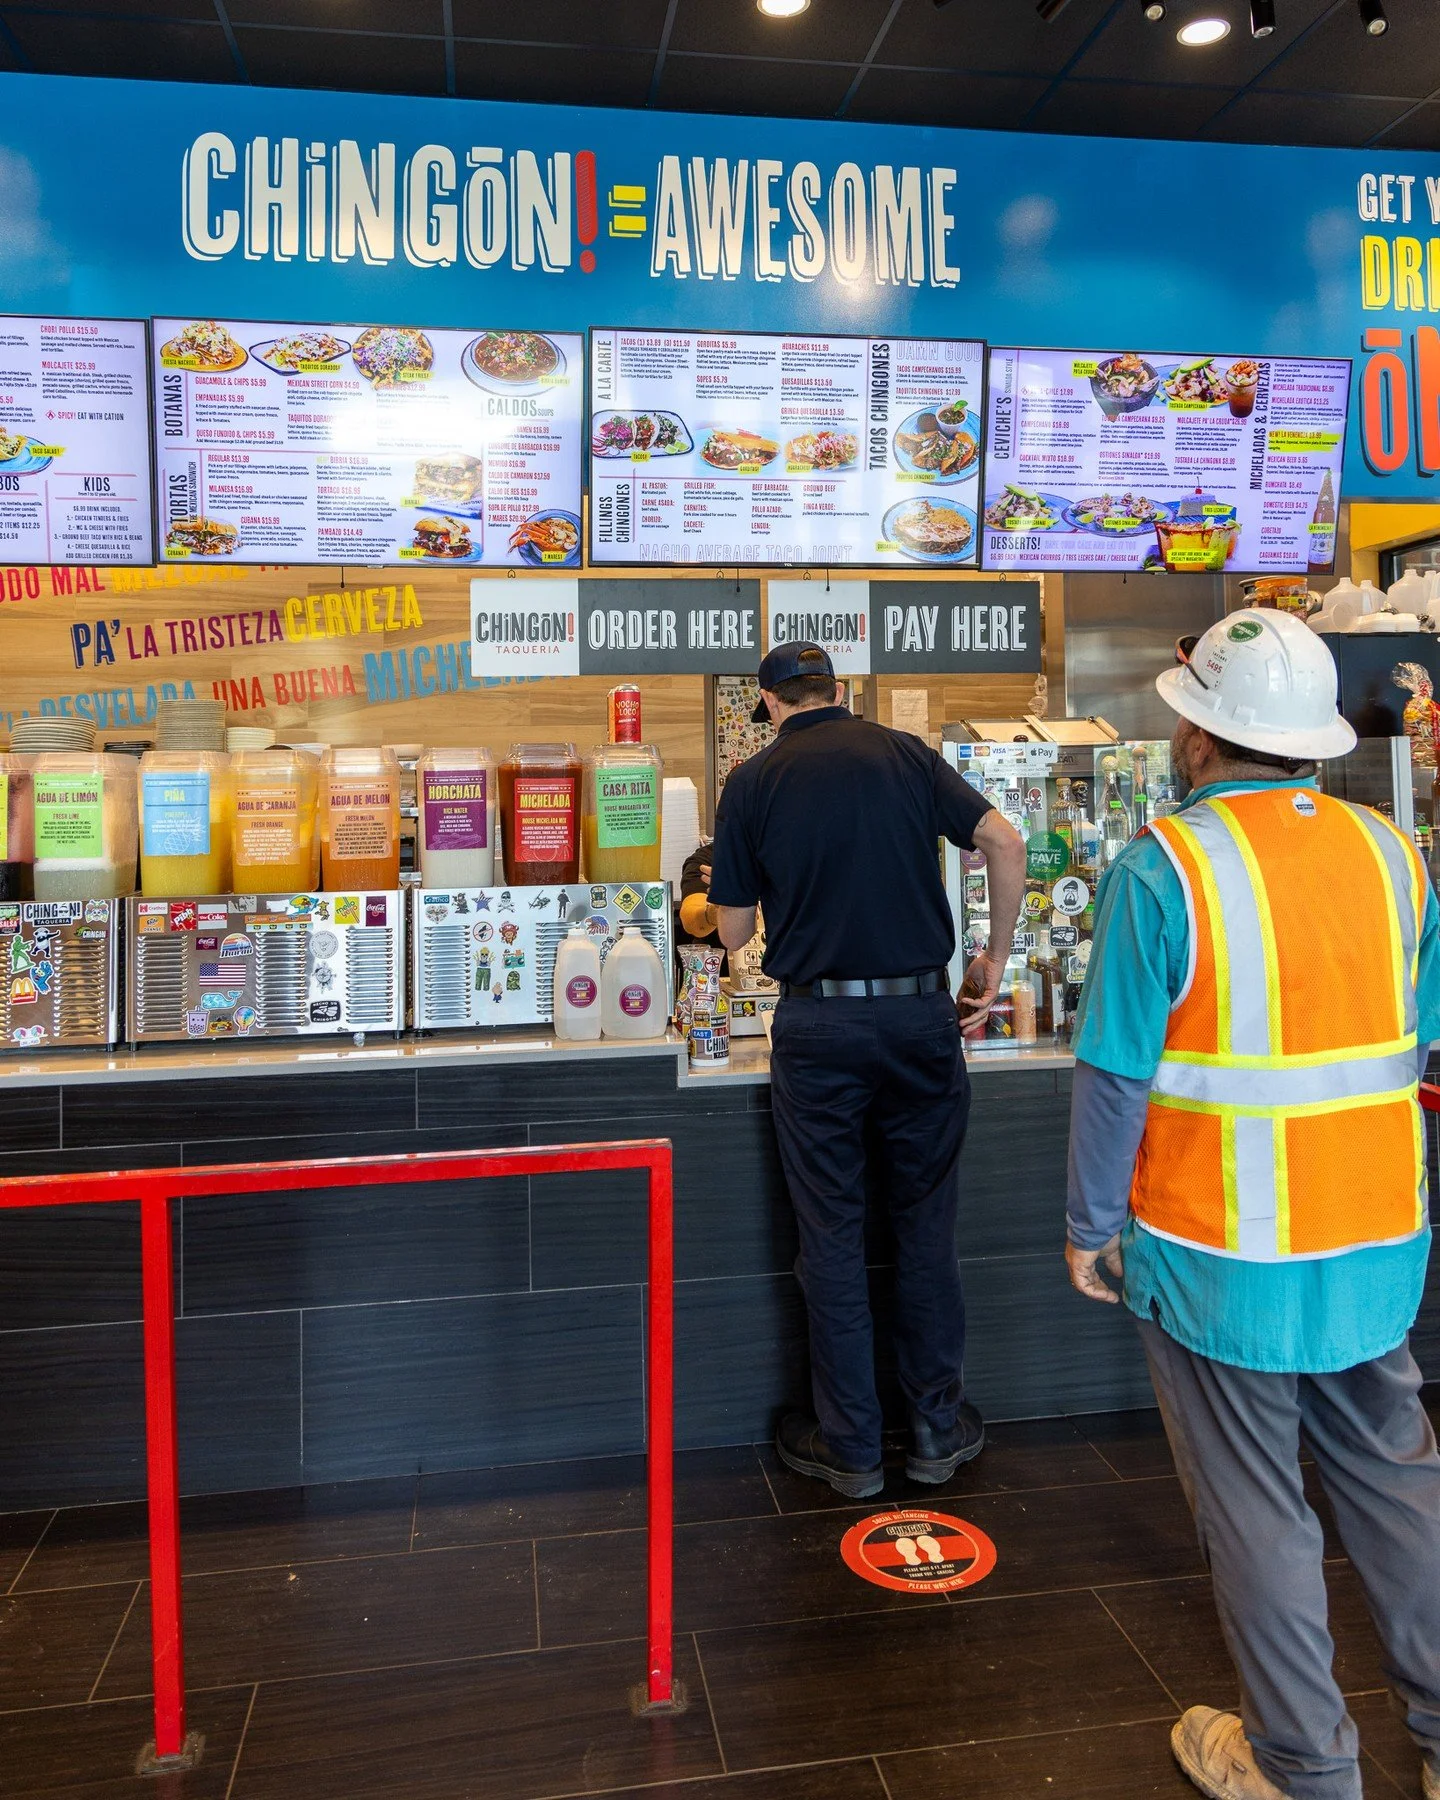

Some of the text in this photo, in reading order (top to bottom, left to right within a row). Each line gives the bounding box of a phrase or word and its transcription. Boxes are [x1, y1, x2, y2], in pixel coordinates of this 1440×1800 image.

[1358, 173, 1415, 224] GET
[650, 155, 961, 290] AWESOME
[696, 340, 720, 348] GORDITAS
[782, 343, 810, 351] HUARACHES
[598, 340, 612, 373] CARTE
[42, 361, 96, 370] MOLCAJETE $25.99
[195, 376, 267, 387] GUACAMOLE & CHIPS $5.99
[287, 380, 310, 388] MEXICAN
[311, 380, 328, 388] STREET
[598, 377, 612, 390] LA
[782, 378, 813, 386] QUESADILLAS
[164, 374, 183, 436] BOTANAS
[195, 394, 244, 402] EMPANADAS $5.99
[487, 398, 538, 417] CALDOS
[870, 343, 890, 470] TACOS CHINGONES
[58, 411, 124, 420] SPICY! EAT WITH CATION
[1250, 362, 1271, 490] MICHELADAS & CERVEZAS
[196, 430, 211, 438] QUESO
[212, 430, 235, 438] FUNDIDO
[258, 431, 274, 439] $5.99
[188, 462, 197, 489] SANDWICH
[84, 476, 110, 492] KIDS
[170, 474, 188, 524] TORTAS
[189, 490, 197, 512] MEXICAN
[599, 484, 630, 543] FILLINGS CHINGONES
[990, 536, 1041, 550] DESSERTS!
[50, 566, 106, 596] MAL
[70, 583, 424, 669] PA' LA TRISTEZA CERVEZA
[586, 608, 756, 651] ORDER HERE
[884, 604, 1028, 653] PAY HERE
[496, 645, 560, 655] TAQUERIA
[212, 676, 267, 712] UNA
[275, 664, 356, 706] BUENA
[616, 700, 640, 710] VOCHO
[619, 708, 636, 716] LOCO
[1038, 748, 1054, 758] Pay
[36, 789, 98, 803] AGUA DE LIMÓN
[164, 788, 186, 803] PIÑA
[428, 784, 482, 800] HORCHATA
[602, 781, 650, 797] CASA RITA
[330, 793, 390, 806] AGUA DE MELON
[520, 794, 570, 808] MICHELADA
[1006, 792, 1020, 801] NO
[237, 801, 255, 811] AGUA
[256, 801, 264, 811] DE
[1030, 854, 1061, 865] FAVE
[872, 1513, 929, 1524] SOCIAL DISTANCING
[932, 1582, 950, 1590] WAIT
[950, 1578, 966, 1586] HERE
